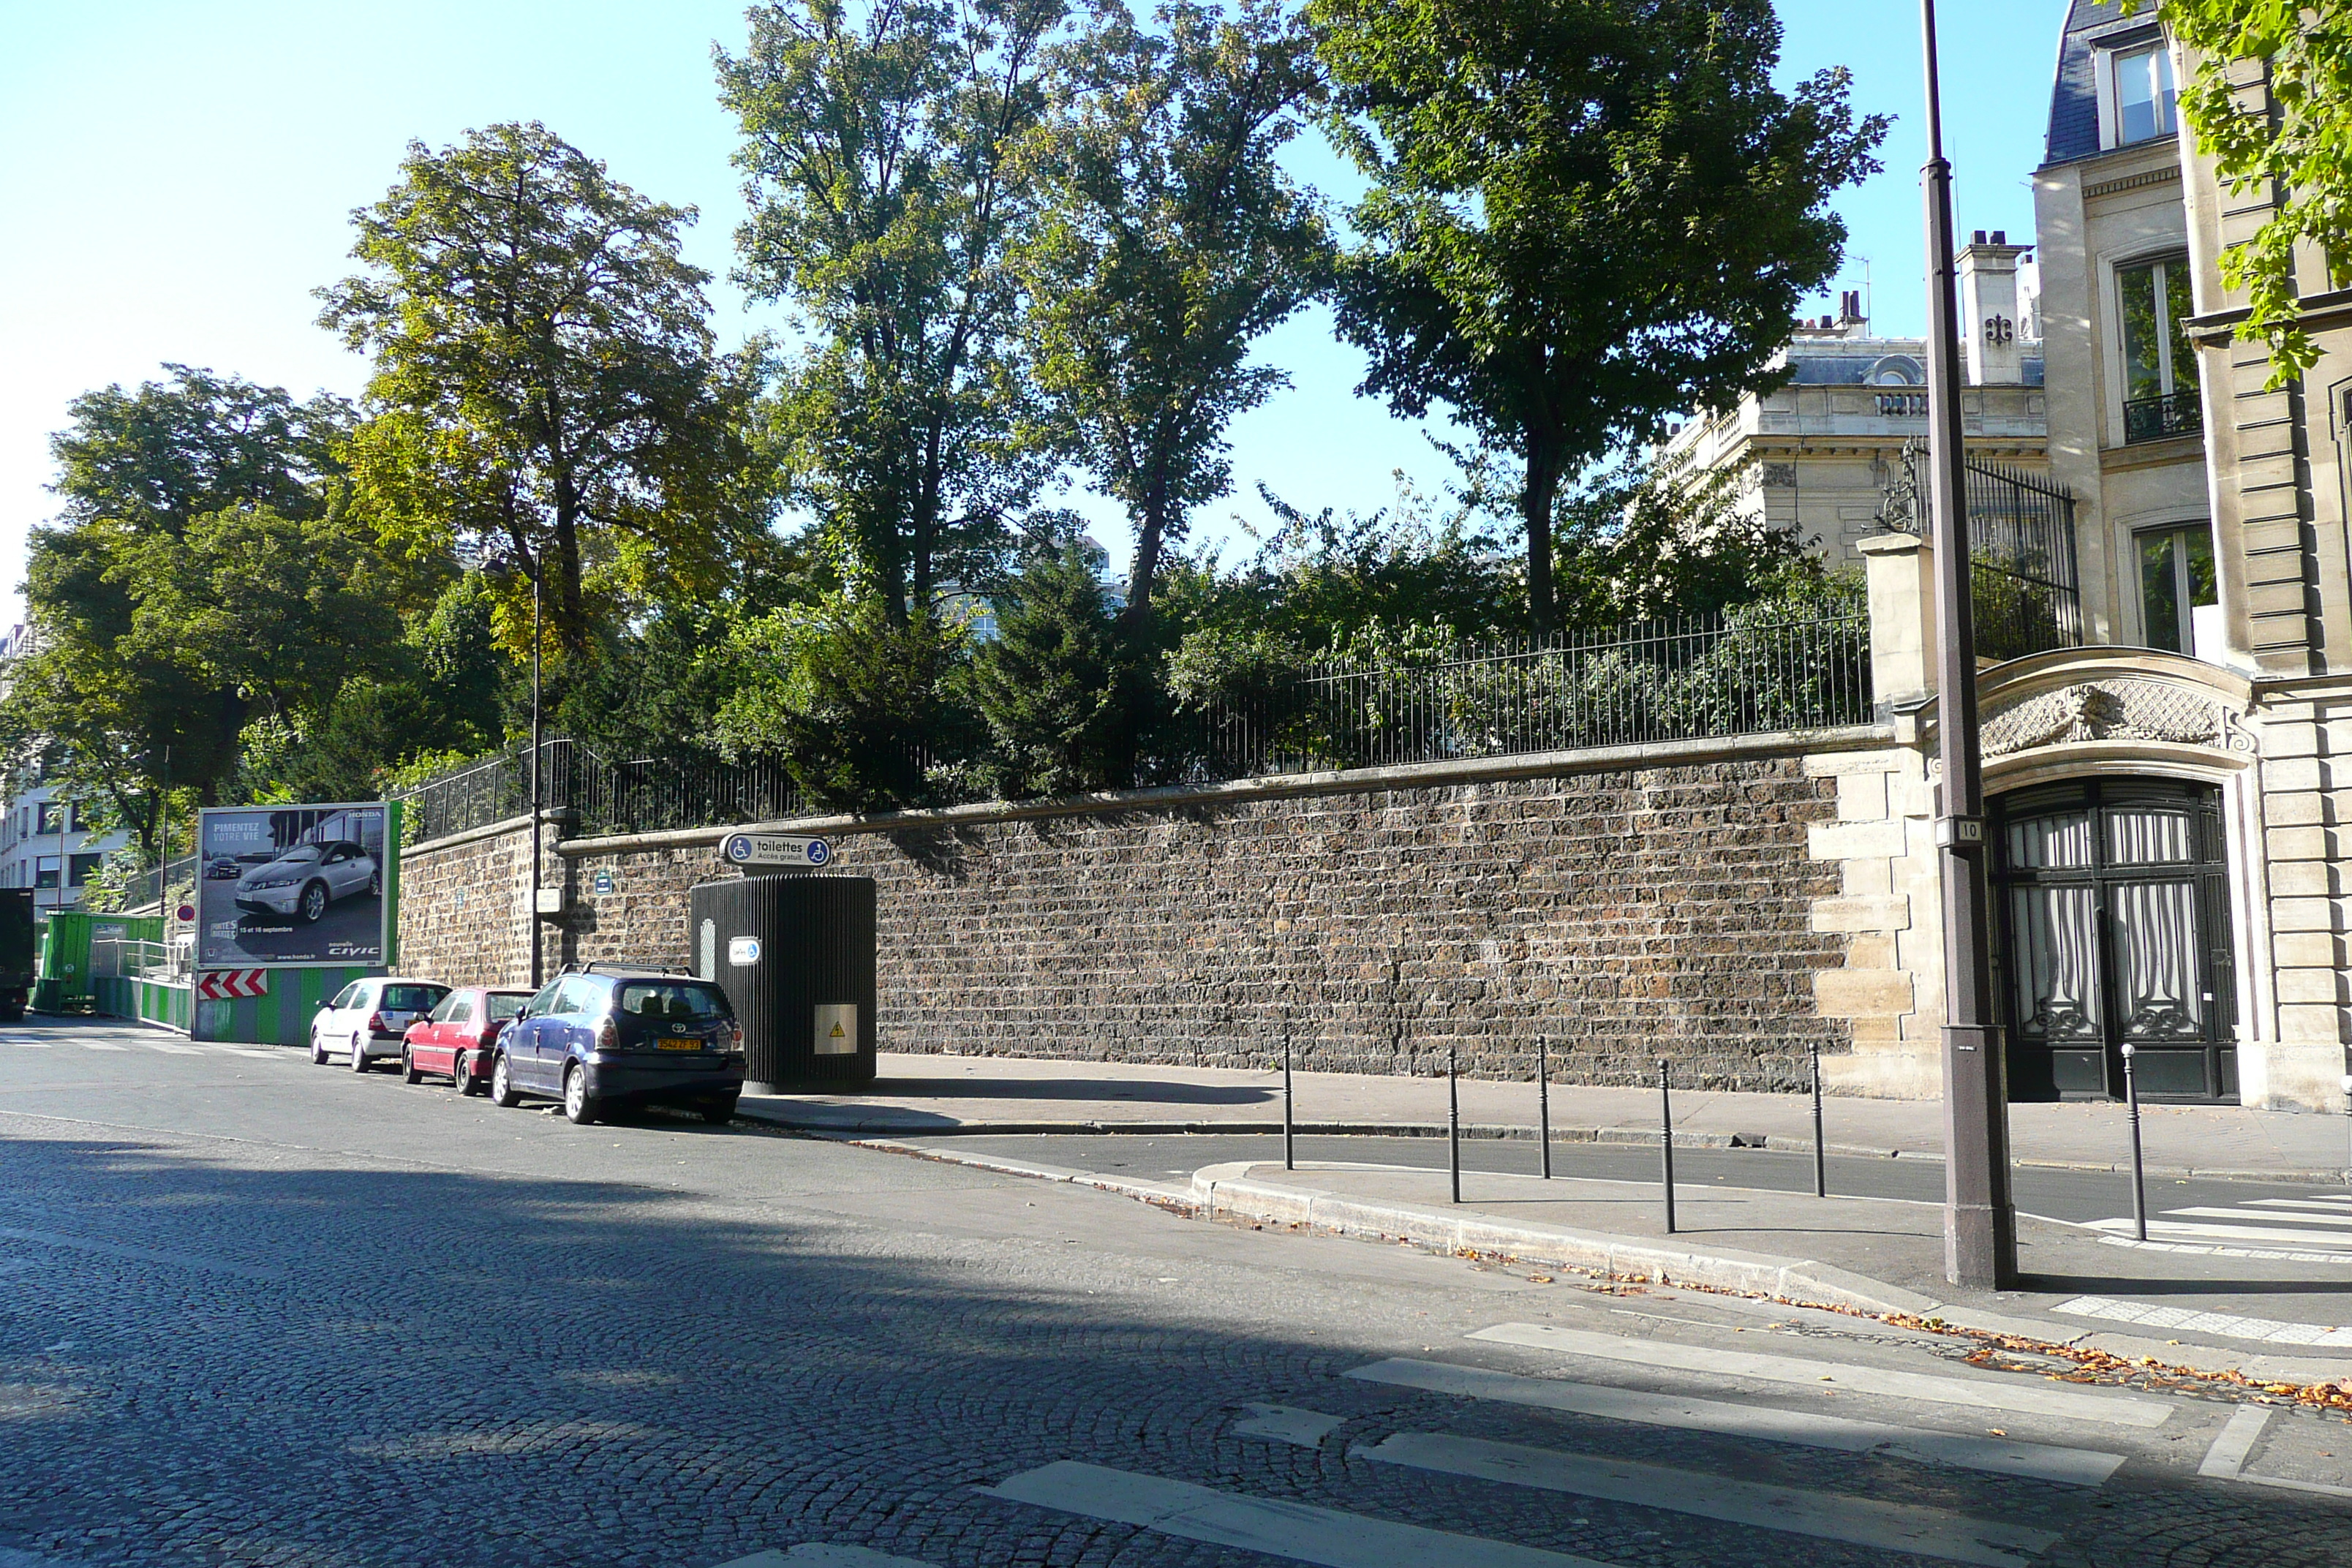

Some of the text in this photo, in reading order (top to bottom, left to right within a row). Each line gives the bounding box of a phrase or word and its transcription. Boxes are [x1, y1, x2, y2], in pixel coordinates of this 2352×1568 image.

[214, 823, 259, 832] PIMENTEZ
[1964, 823, 1977, 837] 10
[214, 832, 259, 840] VOTRE VIE
[757, 840, 802, 853] toilettes
[328, 947, 380, 957] CIVIC
[658, 1039, 676, 1049] 3542
[690, 1040, 699, 1049] 93
